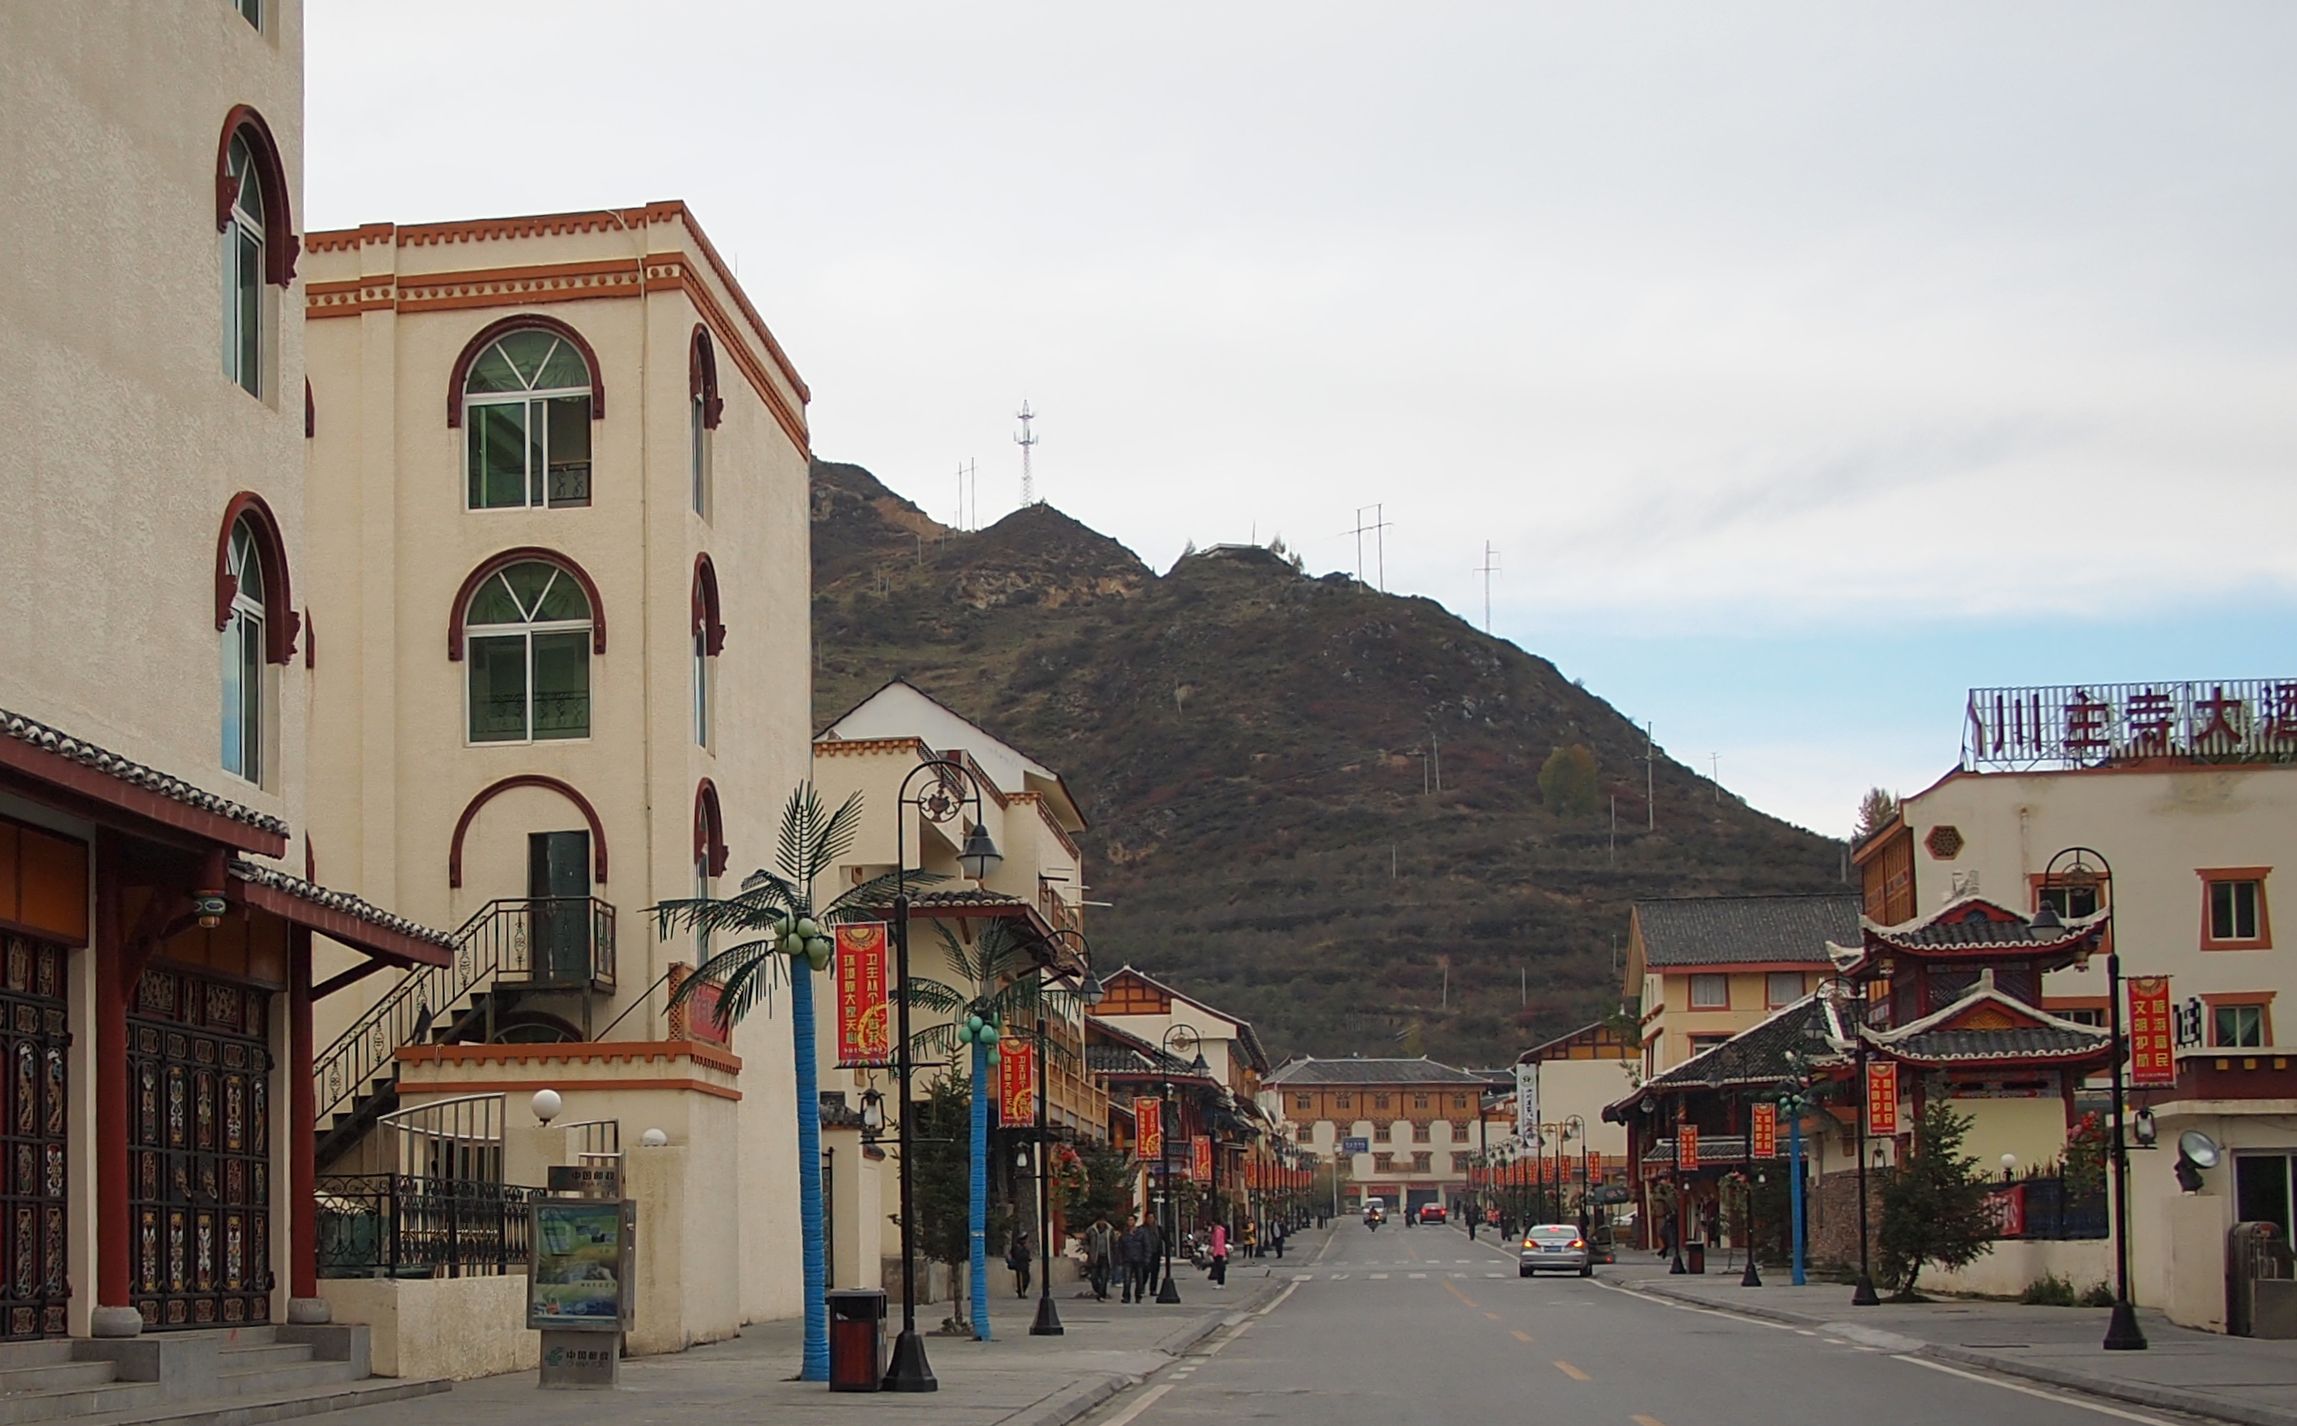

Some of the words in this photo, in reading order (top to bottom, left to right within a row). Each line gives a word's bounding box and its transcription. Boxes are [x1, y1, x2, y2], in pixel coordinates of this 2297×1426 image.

[2133, 1001, 2149, 1068] 文明护航
[2153, 1000, 2169, 1067] 旅游富民
